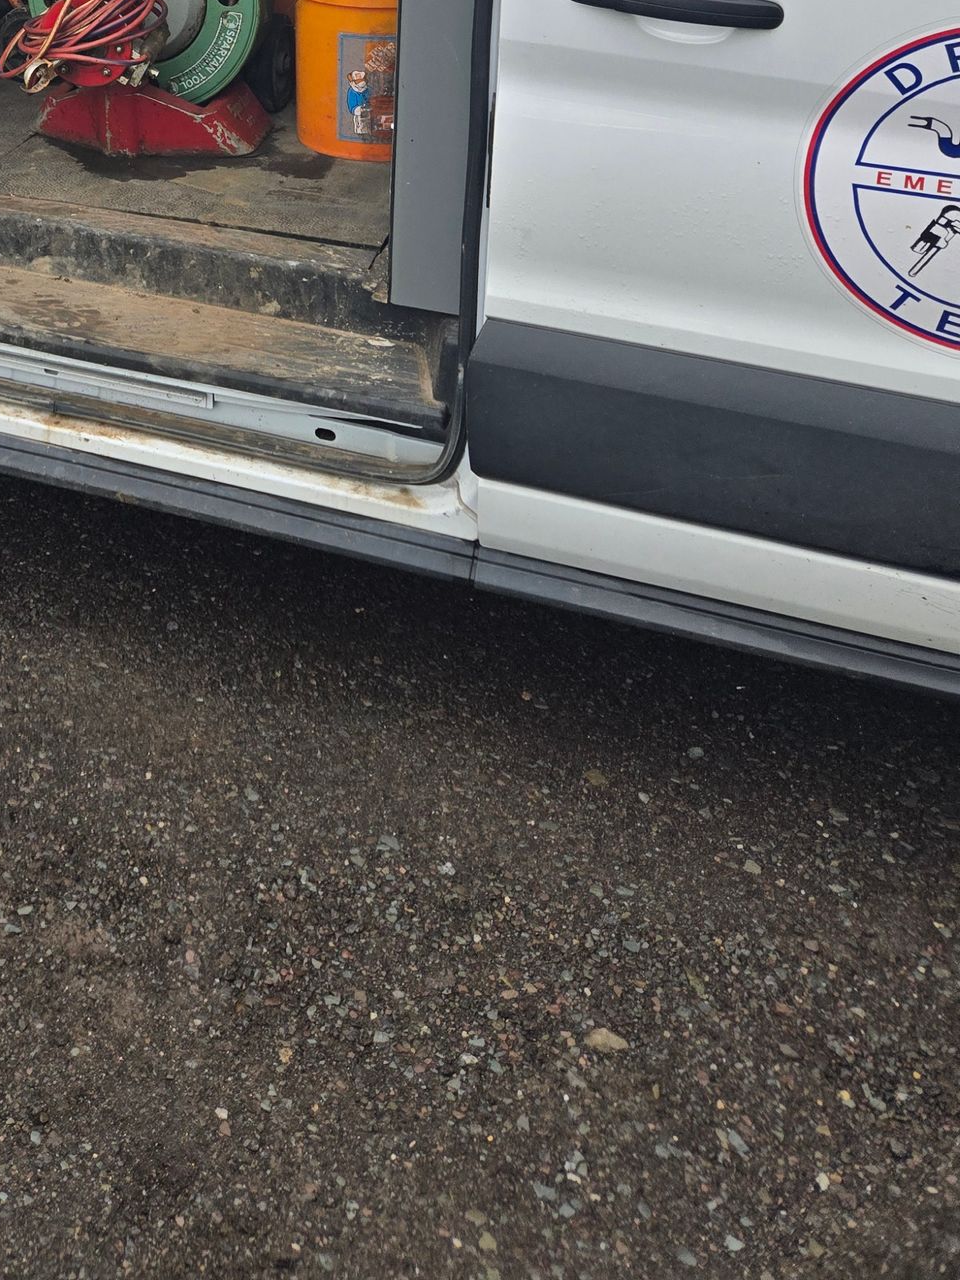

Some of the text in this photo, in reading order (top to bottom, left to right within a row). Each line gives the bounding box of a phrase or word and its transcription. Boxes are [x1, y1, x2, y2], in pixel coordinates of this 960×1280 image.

[204, 27, 236, 74] SPARTAN
[178, 72, 207, 90] TOOL
[876, 171, 953, 195] EME
[889, 284, 960, 339] TE
